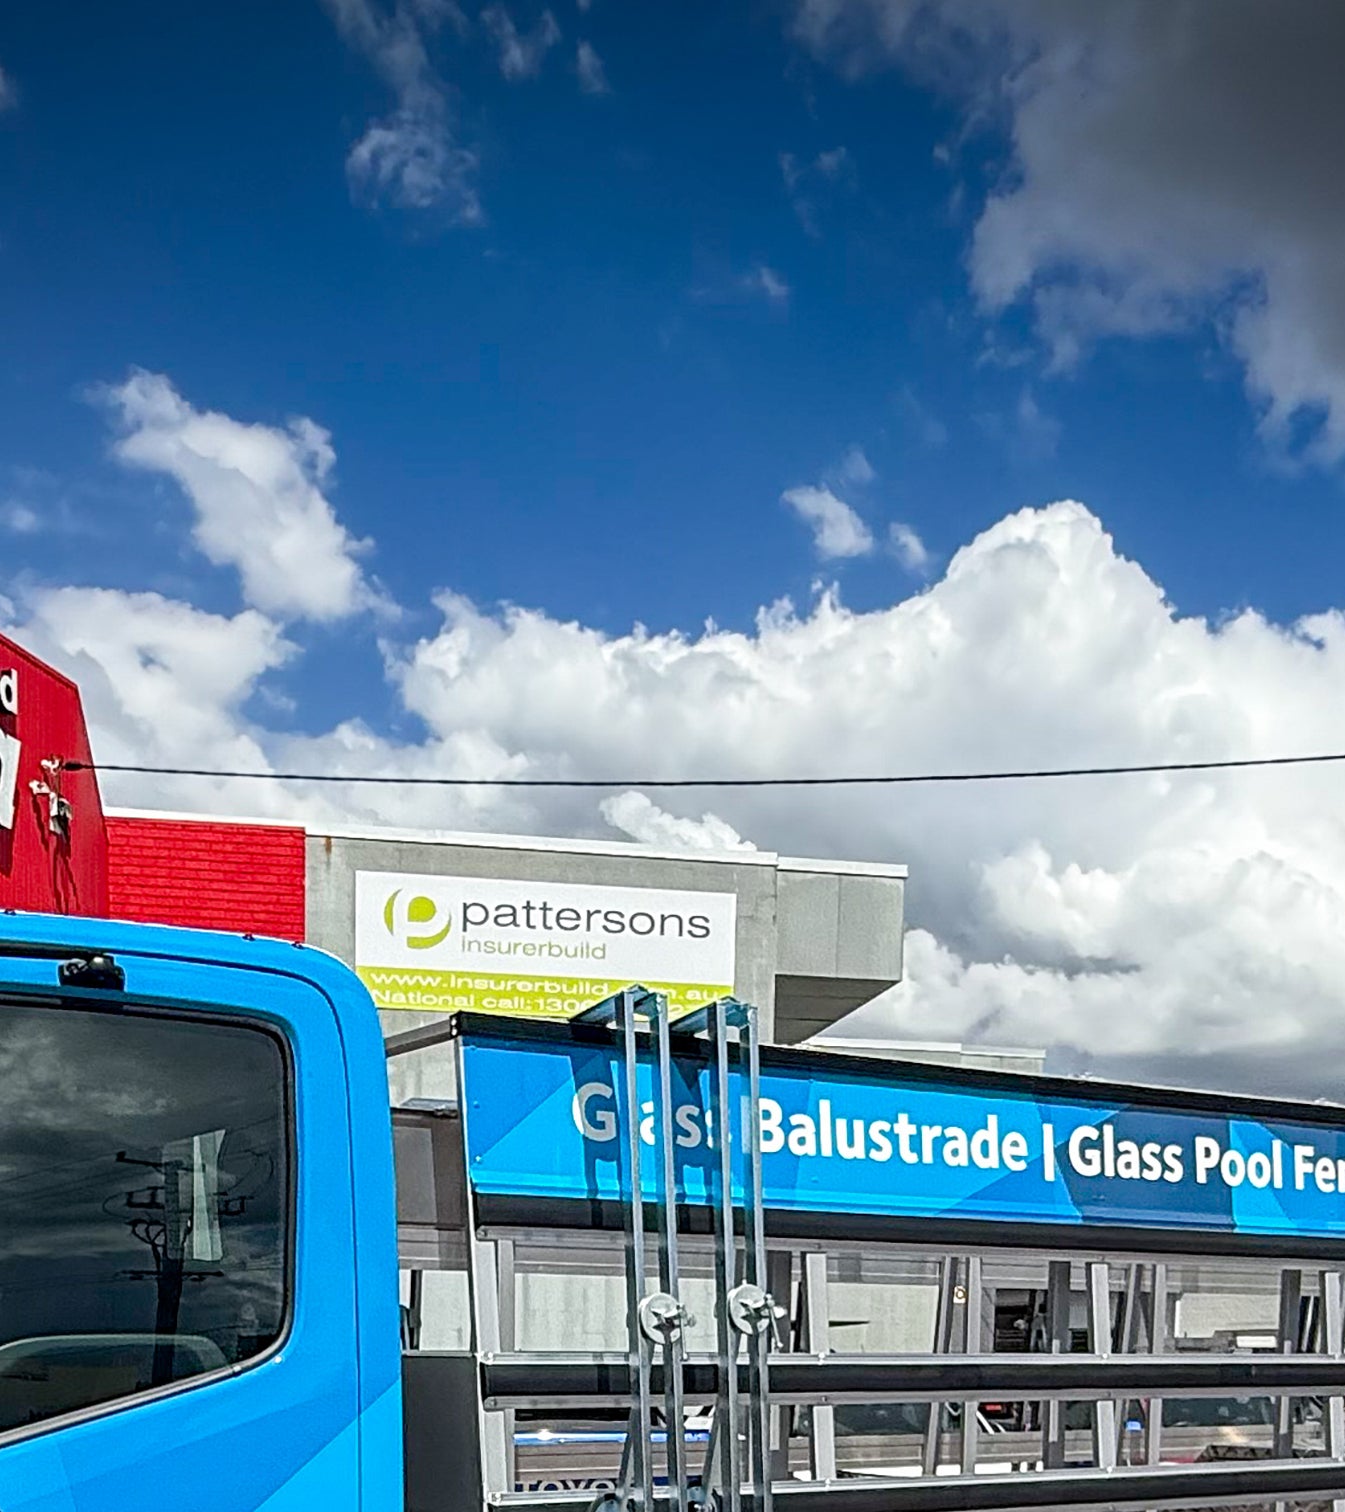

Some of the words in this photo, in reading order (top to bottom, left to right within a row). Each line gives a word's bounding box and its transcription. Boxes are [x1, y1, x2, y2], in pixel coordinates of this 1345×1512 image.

[461, 899, 711, 939] pattersons
[461, 937, 606, 960] insurerbuild
[373, 988, 475, 1009] National
[741, 1095, 1028, 1171] Balustrade
[1068, 1124, 1183, 1183] Glass
[1196, 1137, 1282, 1189] Pool
